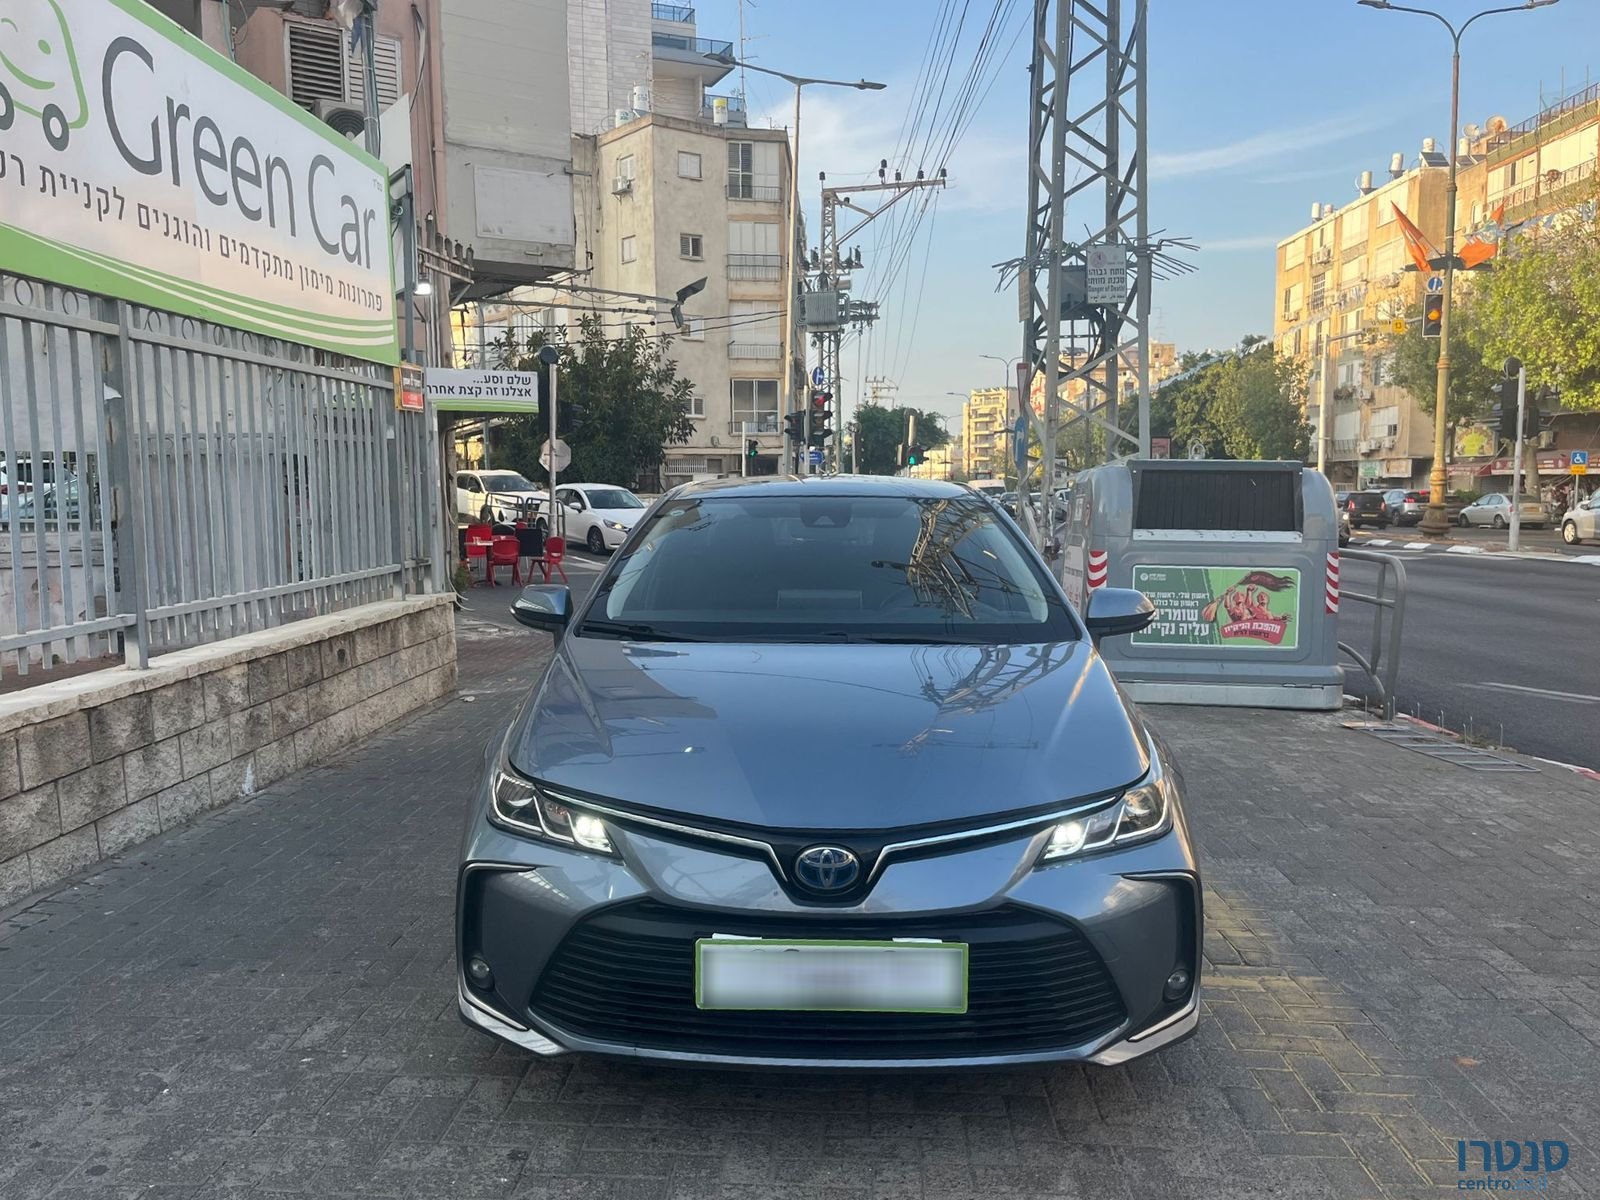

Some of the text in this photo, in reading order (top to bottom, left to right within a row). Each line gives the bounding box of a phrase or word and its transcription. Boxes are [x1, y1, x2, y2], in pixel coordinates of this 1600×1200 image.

[102, 36, 376, 269] Green Car
[39, 165, 126, 222] לקניית
[137, 203, 211, 252] והוגנים
[219, 234, 294, 281] מתקדמים
[299, 264, 334, 295] מימון
[338, 279, 383, 312] פתרונות
[458, 385, 482, 397] קצת
[473, 374, 531, 385] שלם וסע...
[486, 386, 498, 396] זה
[501, 385, 532, 397] אצלנו
[1179, 622, 1210, 636] עליה
